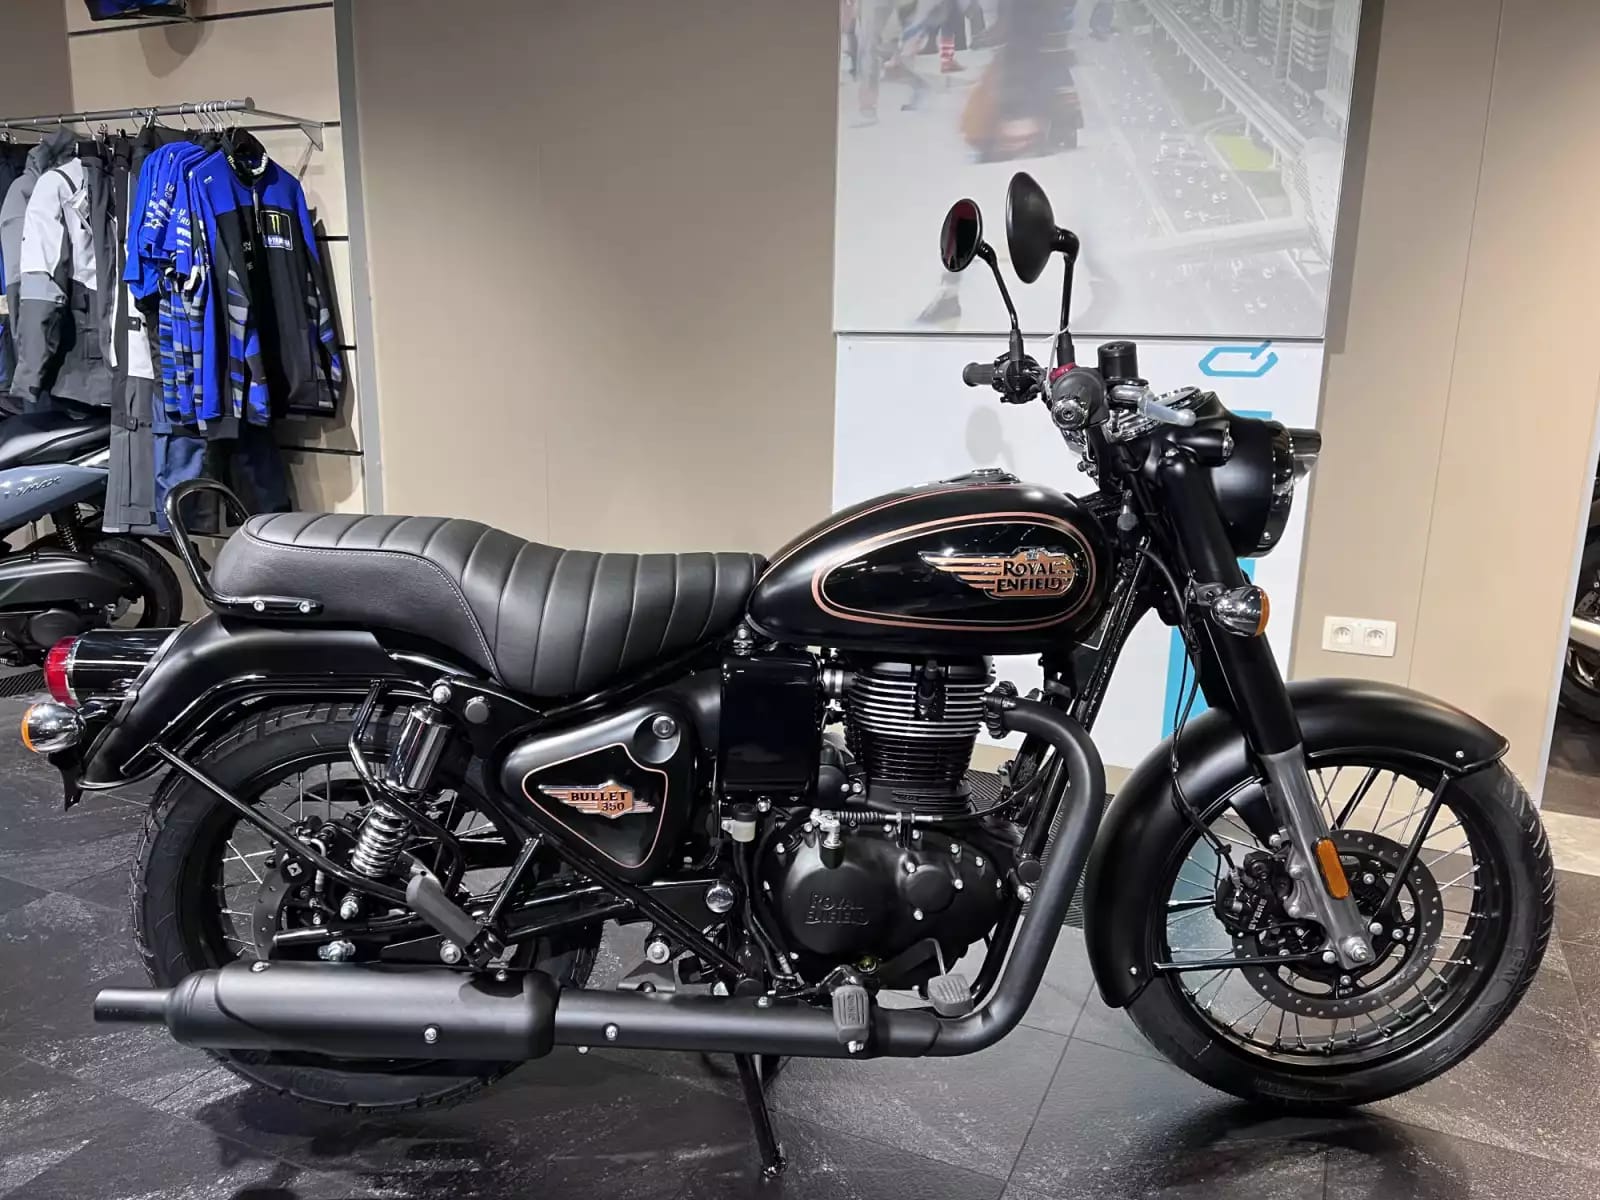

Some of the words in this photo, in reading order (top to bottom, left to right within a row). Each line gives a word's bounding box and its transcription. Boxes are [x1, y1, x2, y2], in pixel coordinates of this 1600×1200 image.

[1003, 560, 1056, 576] ROYAL
[996, 577, 1062, 593] ENFIELD
[571, 791, 628, 801] BULLET
[602, 802, 625, 811] 350
